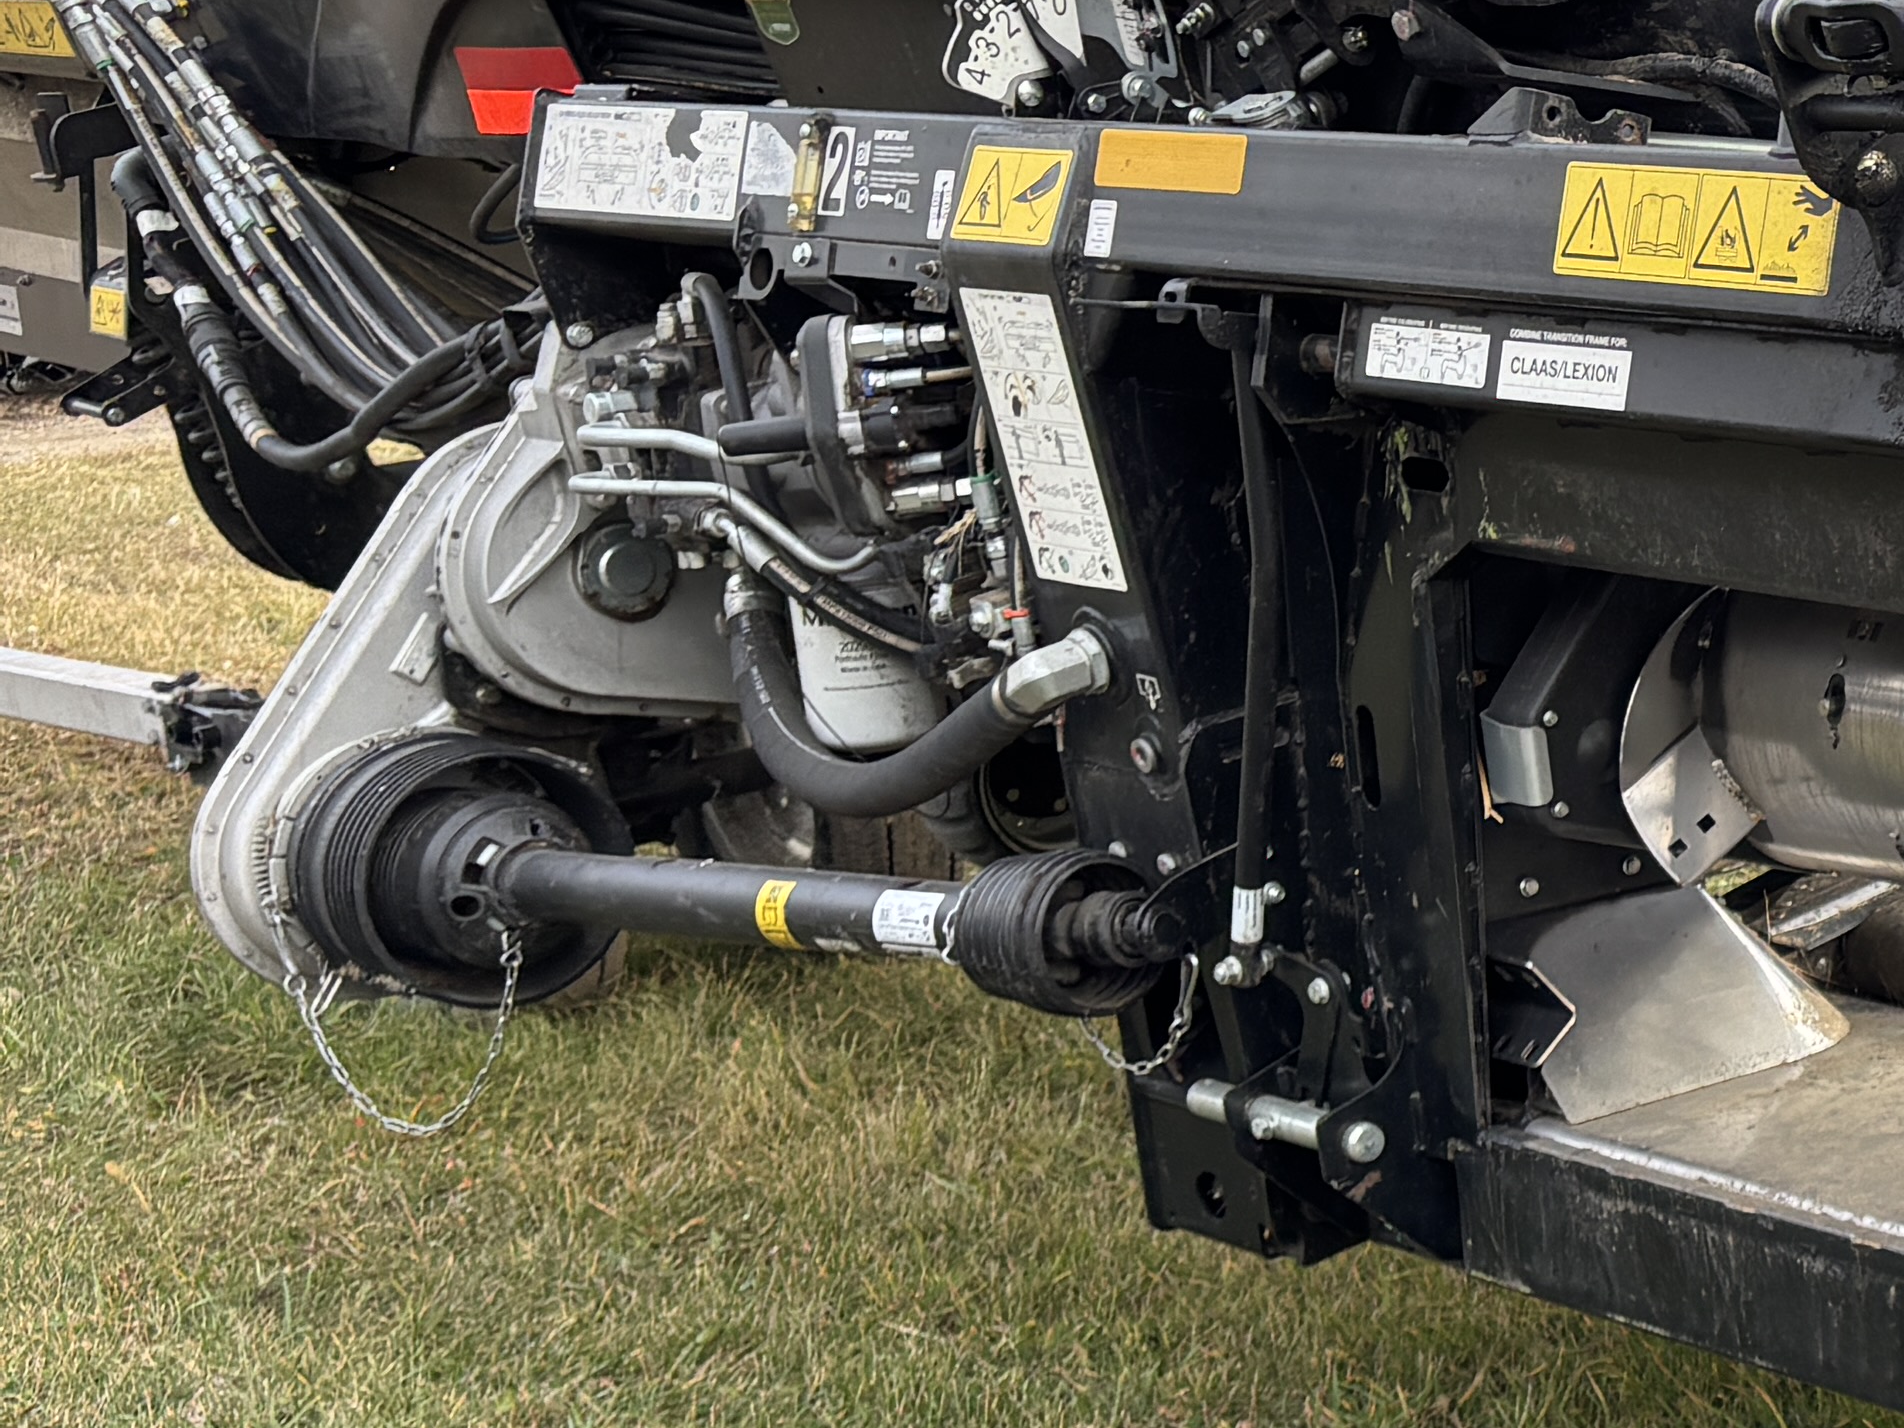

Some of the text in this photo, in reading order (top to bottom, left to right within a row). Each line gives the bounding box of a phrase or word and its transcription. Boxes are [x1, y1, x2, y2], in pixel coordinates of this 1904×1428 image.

[995, 10, 1022, 40] 2
[975, 36, 1001, 59] 3
[964, 67, 992, 86] 4
[821, 130, 850, 212] 2
[1510, 356, 1619, 384] CLAAS/LEXION
